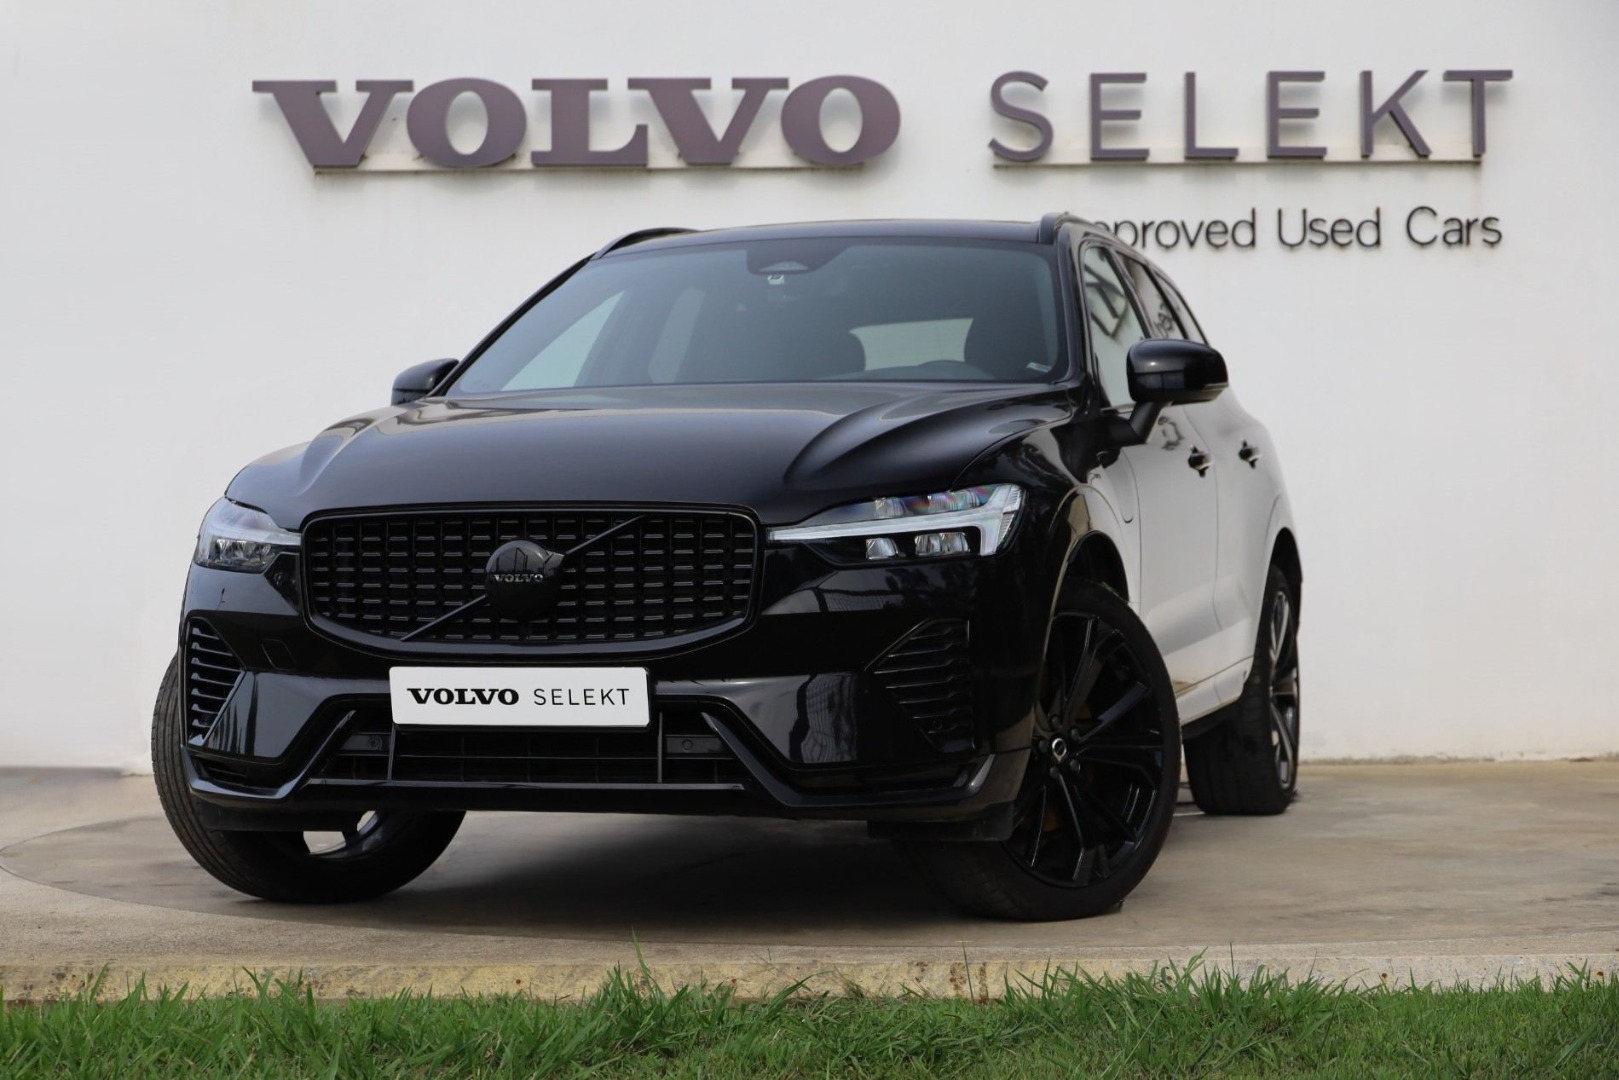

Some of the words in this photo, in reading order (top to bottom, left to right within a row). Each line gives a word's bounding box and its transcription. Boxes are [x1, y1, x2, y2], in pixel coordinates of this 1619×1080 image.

[251, 74, 901, 169] VOLVO
[988, 69, 1514, 162] SELEKT
[1094, 207, 1257, 249] proved
[1277, 206, 1382, 249] Used
[1405, 206, 1504, 248] Cars
[491, 573, 544, 583] VOLVO
[407, 687, 520, 706] VOLVO
[533, 688, 630, 706] SELEKT
